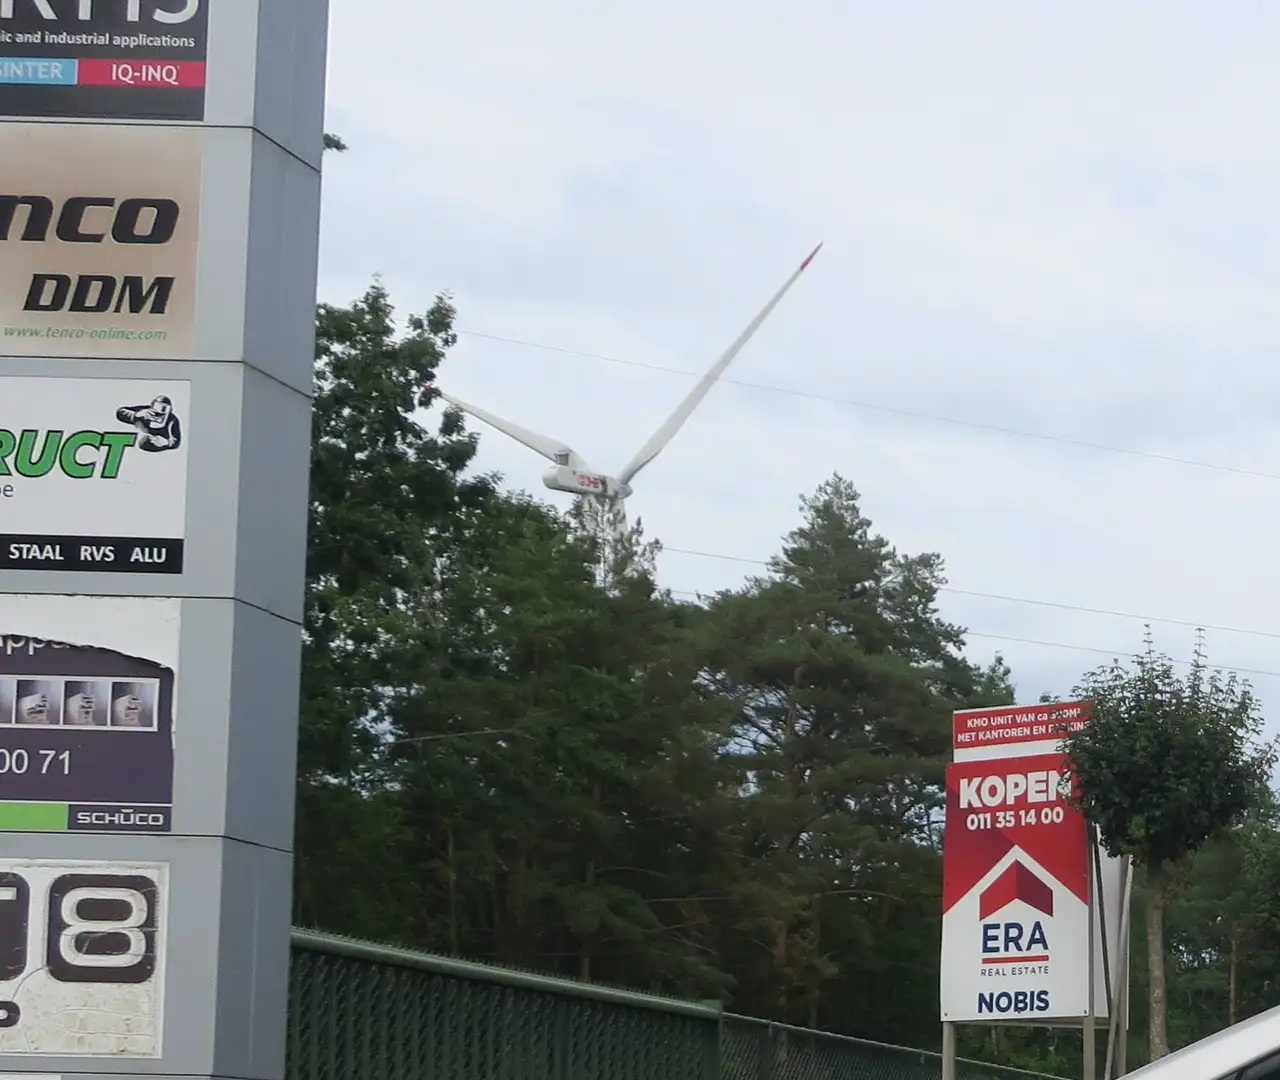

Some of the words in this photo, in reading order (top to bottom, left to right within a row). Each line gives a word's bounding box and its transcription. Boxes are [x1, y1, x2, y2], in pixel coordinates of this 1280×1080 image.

[15, 31, 41, 43] and
[45, 31, 109, 46] industrial
[112, 33, 195, 48] applications
[0, 61, 63, 79] INTER
[22, 273, 175, 315] DDM
[9, 543, 64, 560] STAAL
[80, 546, 115, 562] RVS
[130, 547, 167, 563] ALU
[967, 717, 988, 729] KMO
[991, 714, 1013, 726] UNIT
[1015, 712, 1035, 724] VAN
[1037, 712, 1048, 721] ca
[957, 731, 976, 743] MET
[978, 727, 1030, 741] KANTOREN
[1033, 725, 1045, 735] EN
[39, 750, 70, 775] 71
[959, 770, 1072, 809] KOPEN
[967, 812, 991, 831] 011
[995, 810, 1015, 829] 35
[1019, 809, 1037, 826] 14
[1040, 807, 1064, 824] 00
[981, 921, 1049, 953] ERA
[981, 968, 1006, 977] REAL
[1011, 965, 1049, 976] ESTATE
[978, 989, 1049, 1013] NOBIS
